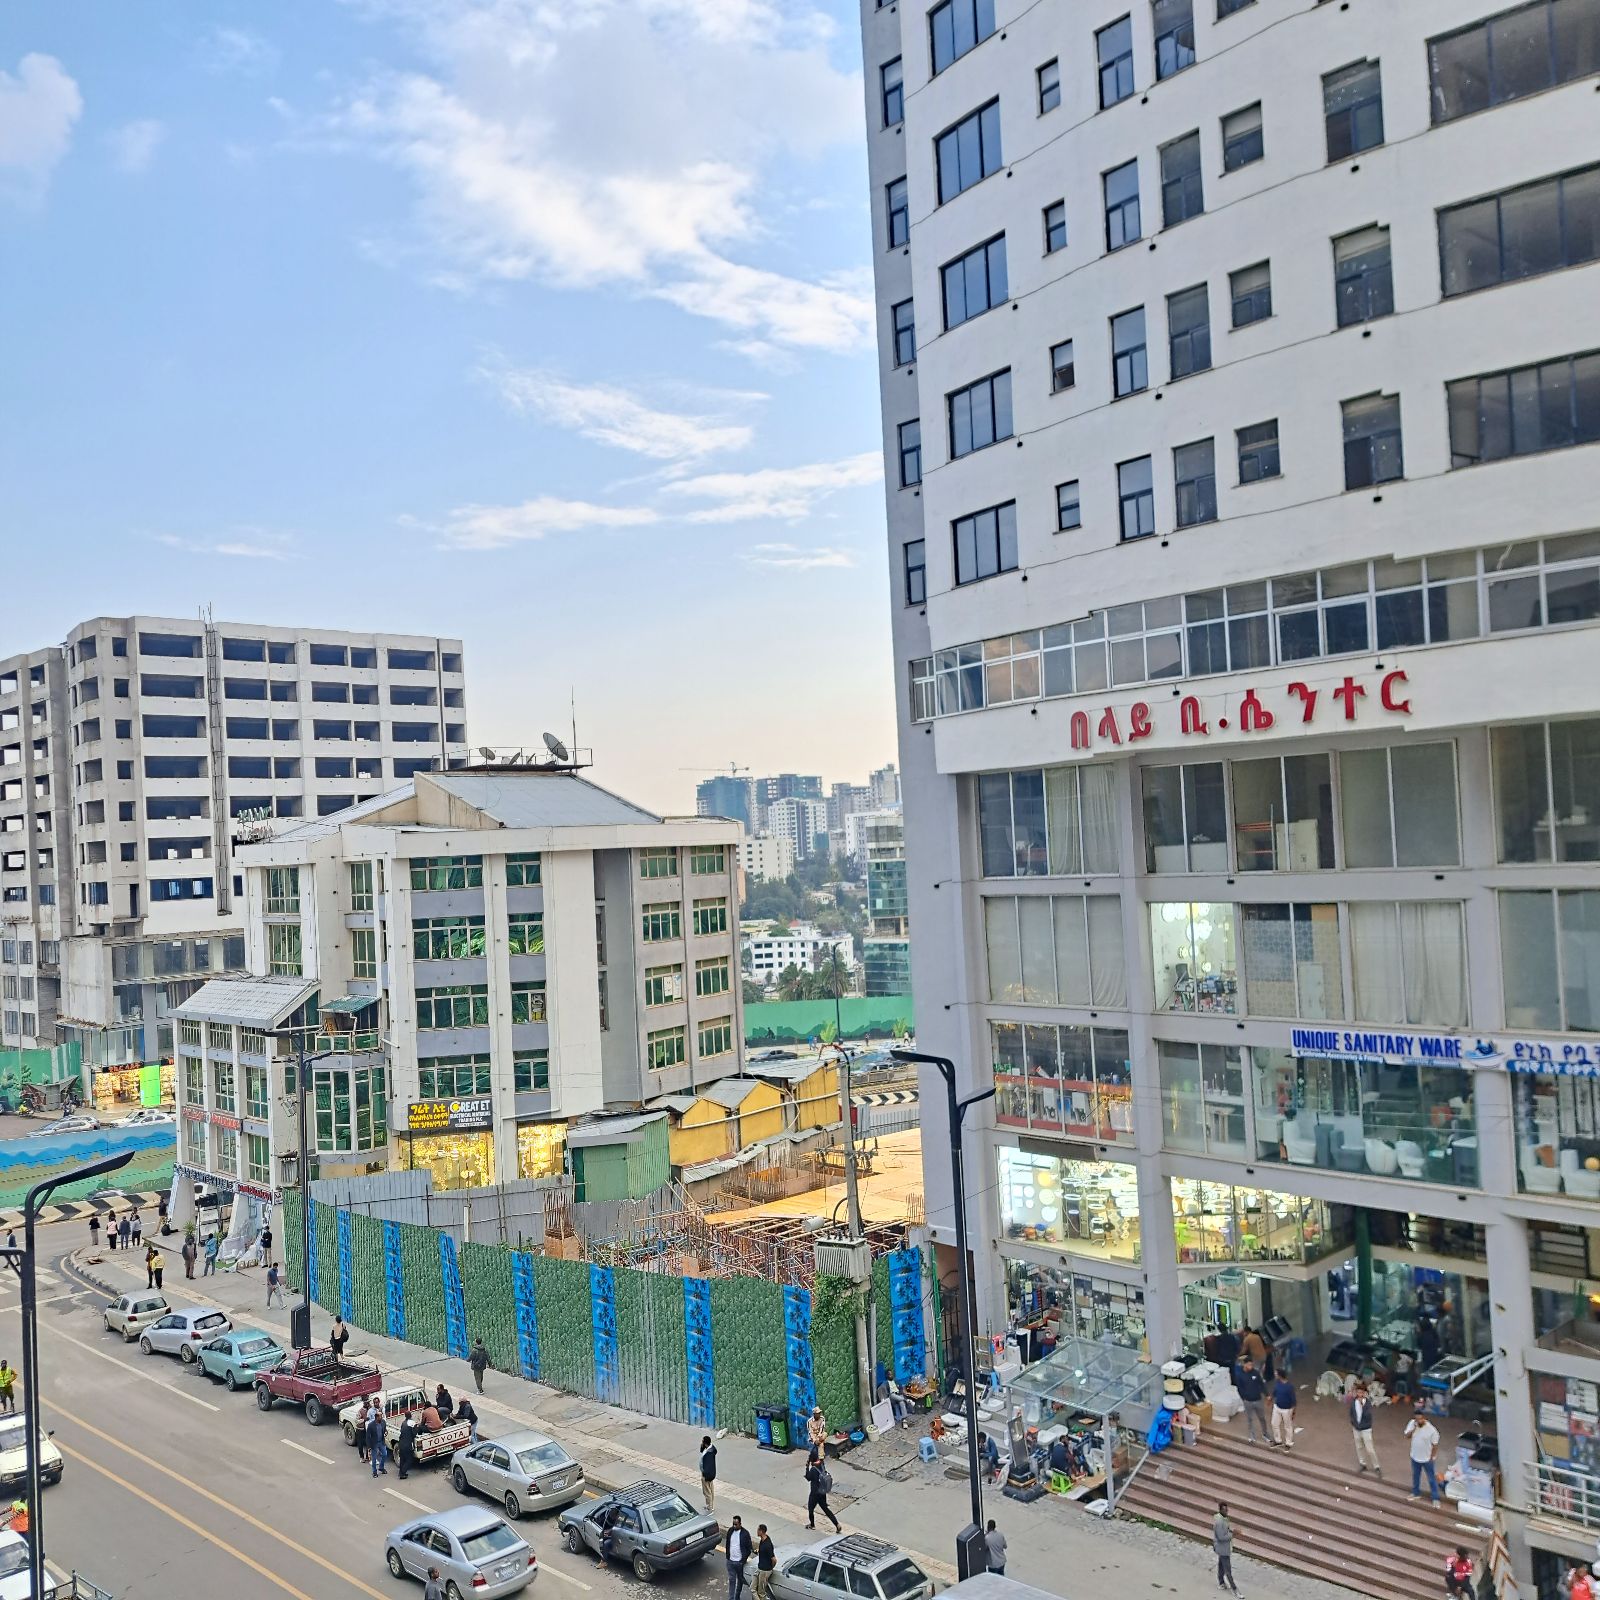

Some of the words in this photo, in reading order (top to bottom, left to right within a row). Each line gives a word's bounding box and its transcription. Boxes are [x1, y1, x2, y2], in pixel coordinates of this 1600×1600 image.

[1070, 702, 1154, 750] በላይ
[1292, 1029, 1340, 1051] UNIQUE
[1344, 1033, 1414, 1056] SANITARY
[1418, 1037, 1463, 1059] WARE
[411, 1103, 430, 1114] ግሬት
[450, 1100, 479, 1113] GREAT
[480, 1099, 490, 1111] ET
[428, 1431, 464, 1446] TOYOTA
